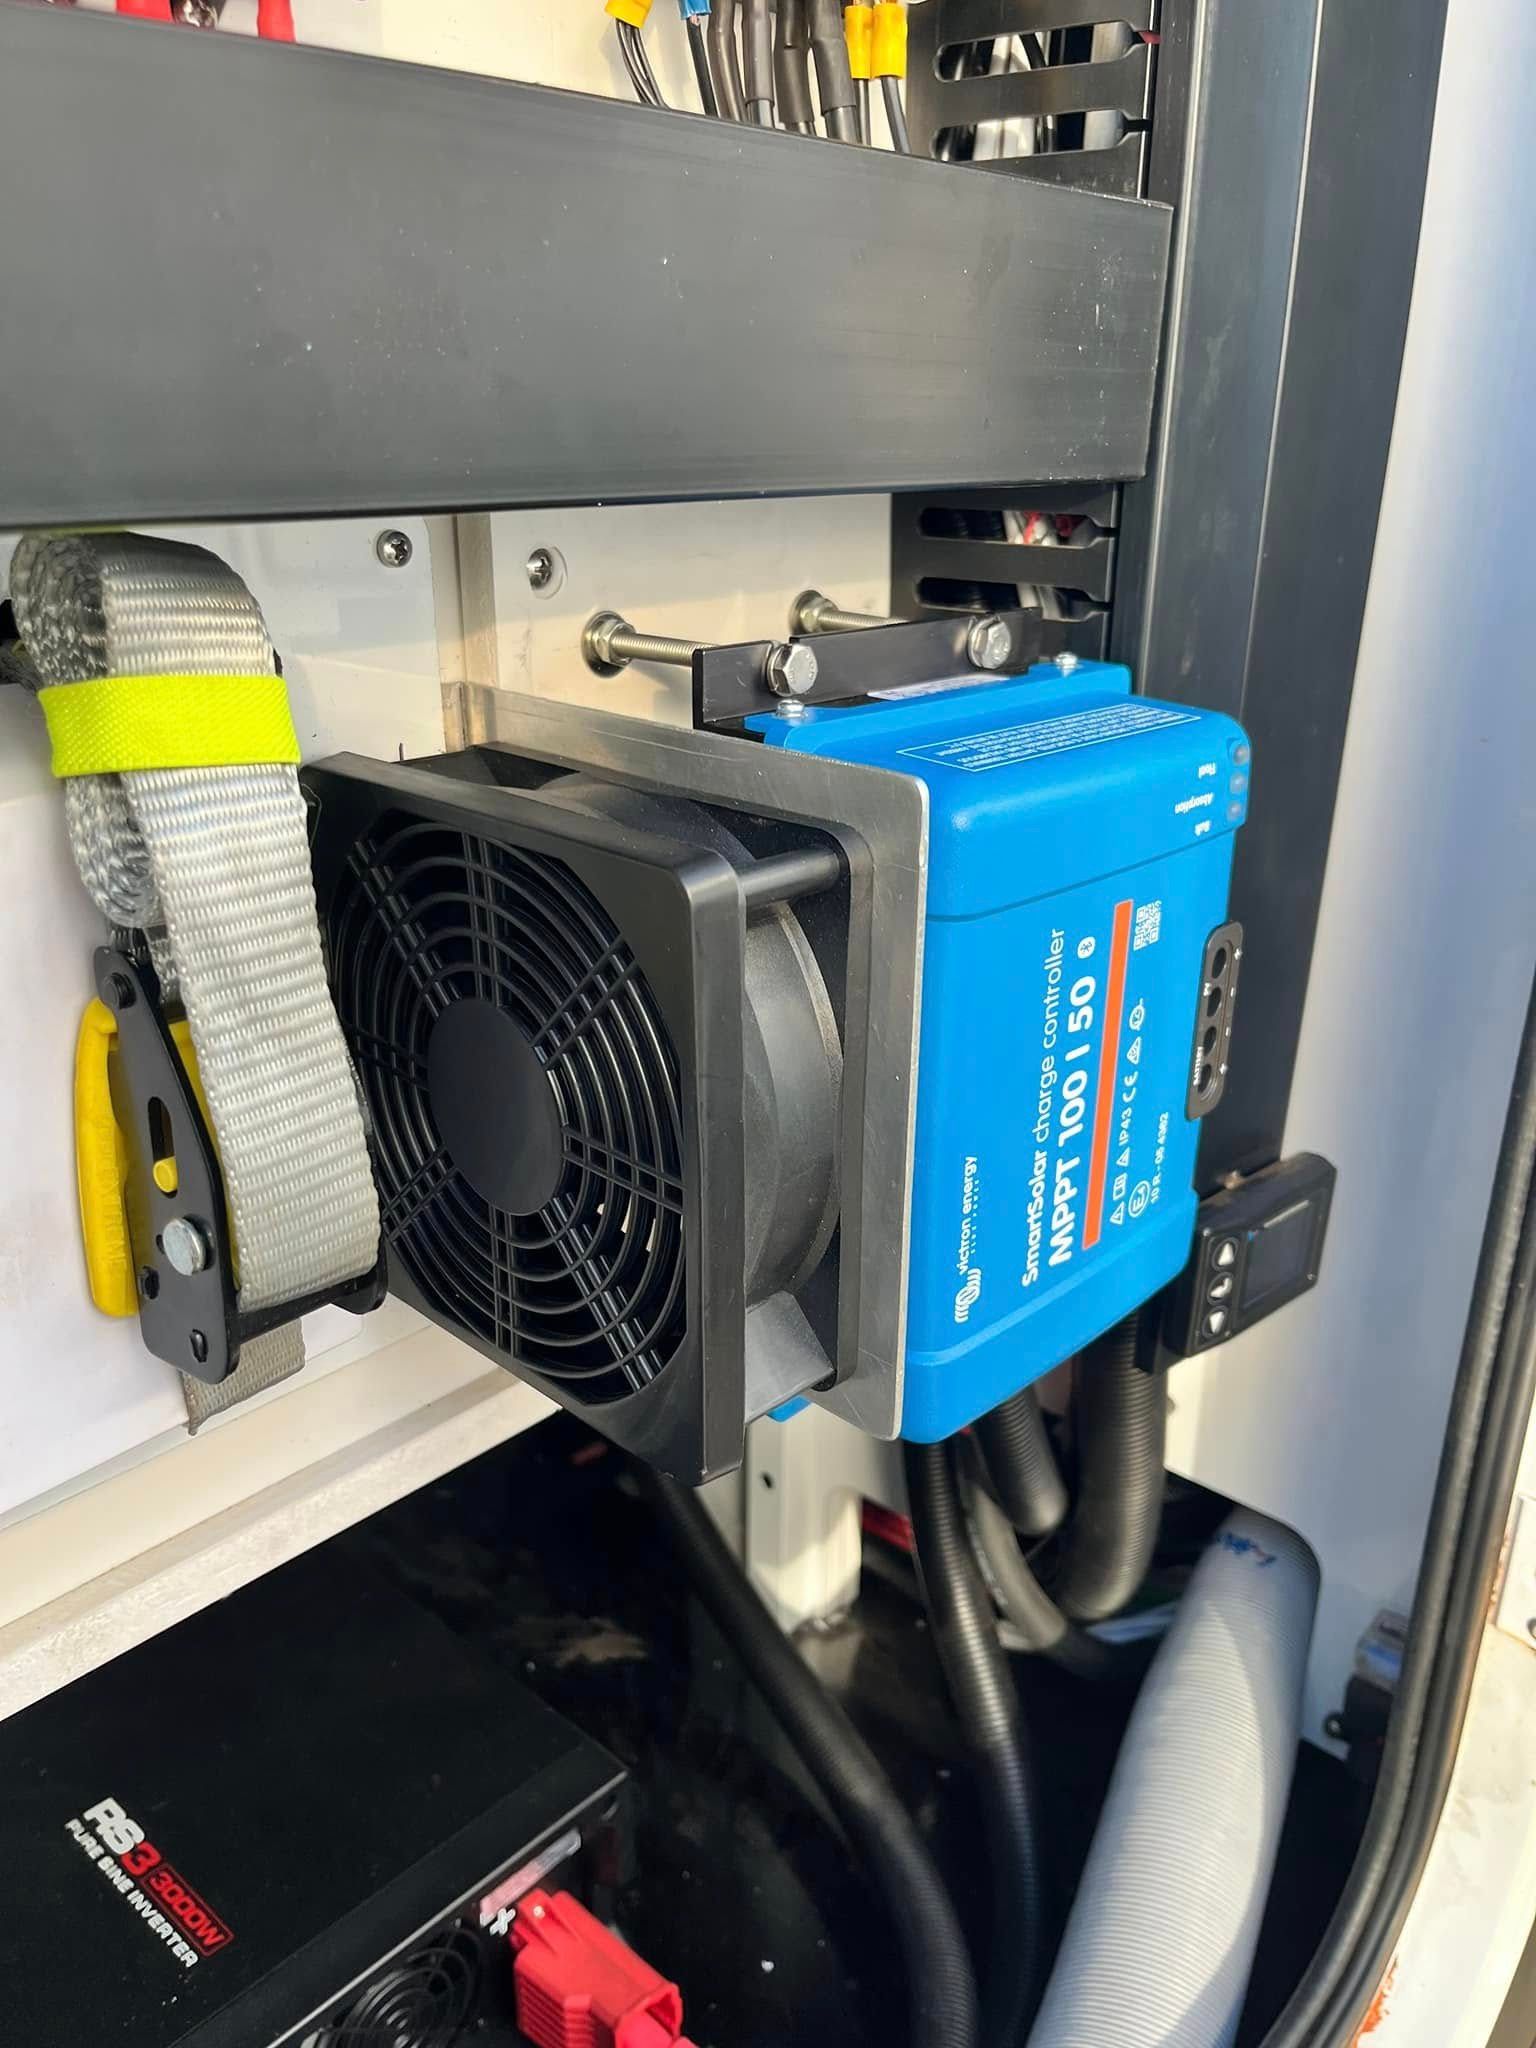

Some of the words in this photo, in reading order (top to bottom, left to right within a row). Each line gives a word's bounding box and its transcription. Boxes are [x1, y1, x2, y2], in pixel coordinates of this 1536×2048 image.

[1175, 792, 1214, 814] Absorption
[1043, 928, 1065, 1049] controller
[1067, 976, 1096, 1033] 50
[1032, 1055, 1057, 1143] charge
[1058, 1070, 1088, 1147] 100
[1118, 1106, 1133, 1146] IP43
[963, 1156, 977, 1214] energy
[1022, 1150, 1047, 1287] SmartSolar
[1048, 1156, 1081, 1267] MPPT
[956, 1217, 971, 1275] victron
[64, 1818, 105, 1861] PURE
[97, 1855, 135, 1894] SINE
[127, 1889, 199, 1968] INVERTER
[149, 1871, 225, 1946] 3000W
